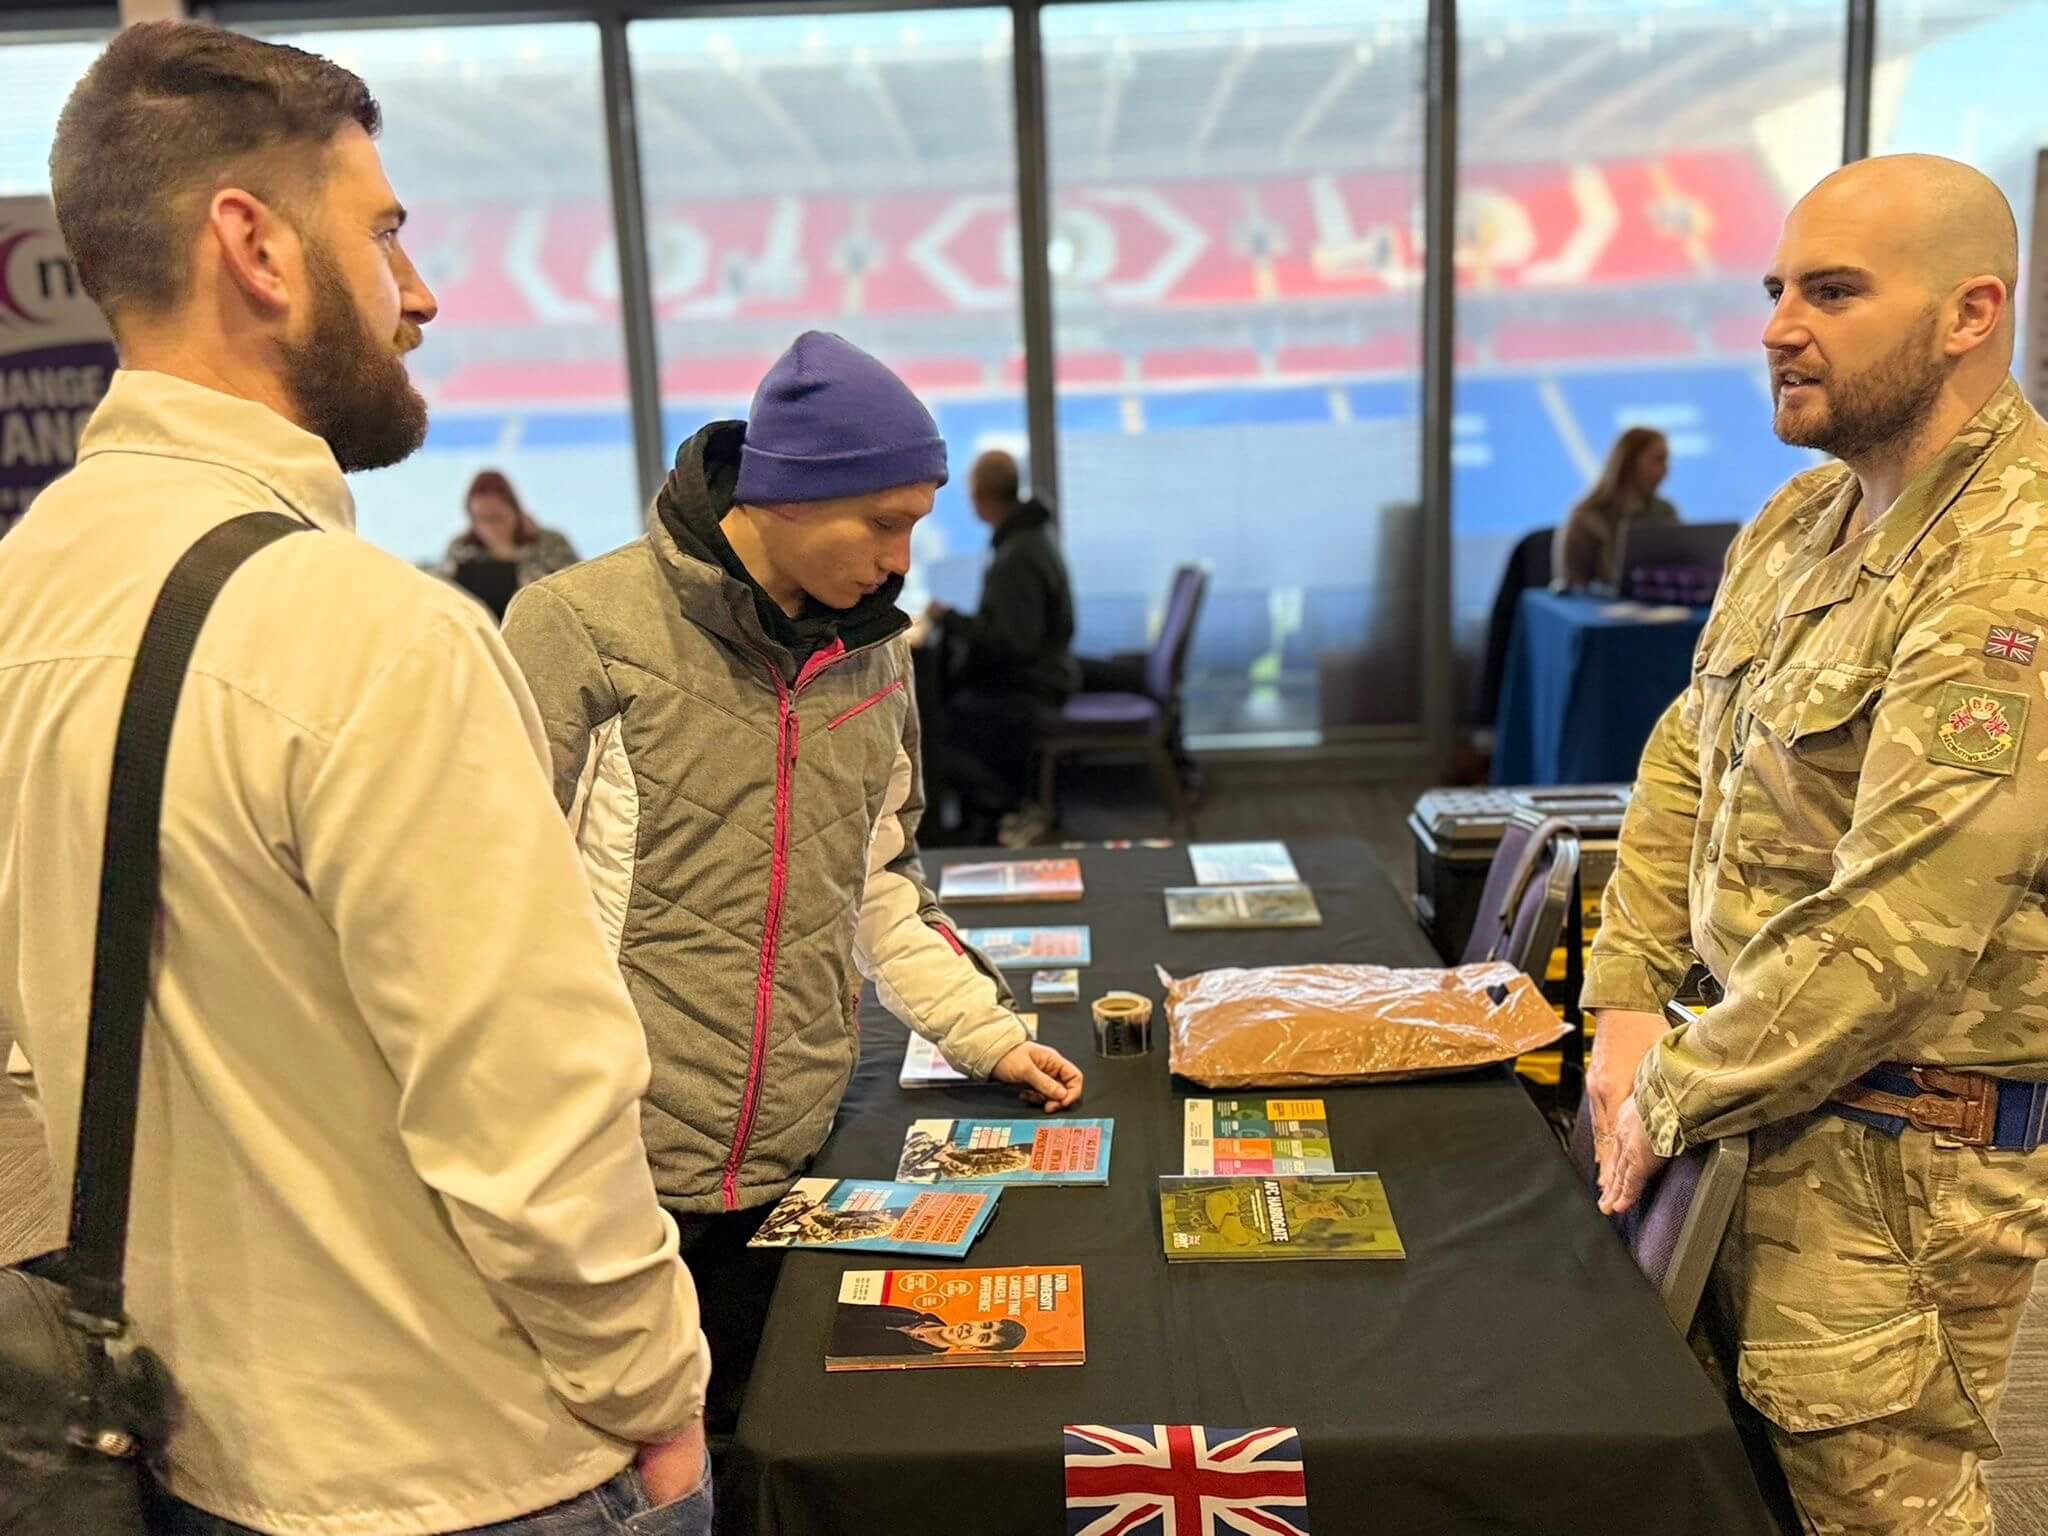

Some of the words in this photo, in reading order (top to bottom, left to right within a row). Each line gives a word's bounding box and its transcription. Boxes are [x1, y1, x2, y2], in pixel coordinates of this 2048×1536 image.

[0, 365, 103, 408] ANGE
[1943, 733, 1979, 761] RECRUITING
[1263, 1181, 1280, 1196] AFC
[1266, 1196, 1288, 1243] HARROGATE
[1040, 1274, 1053, 1311] UNIVERSITY
